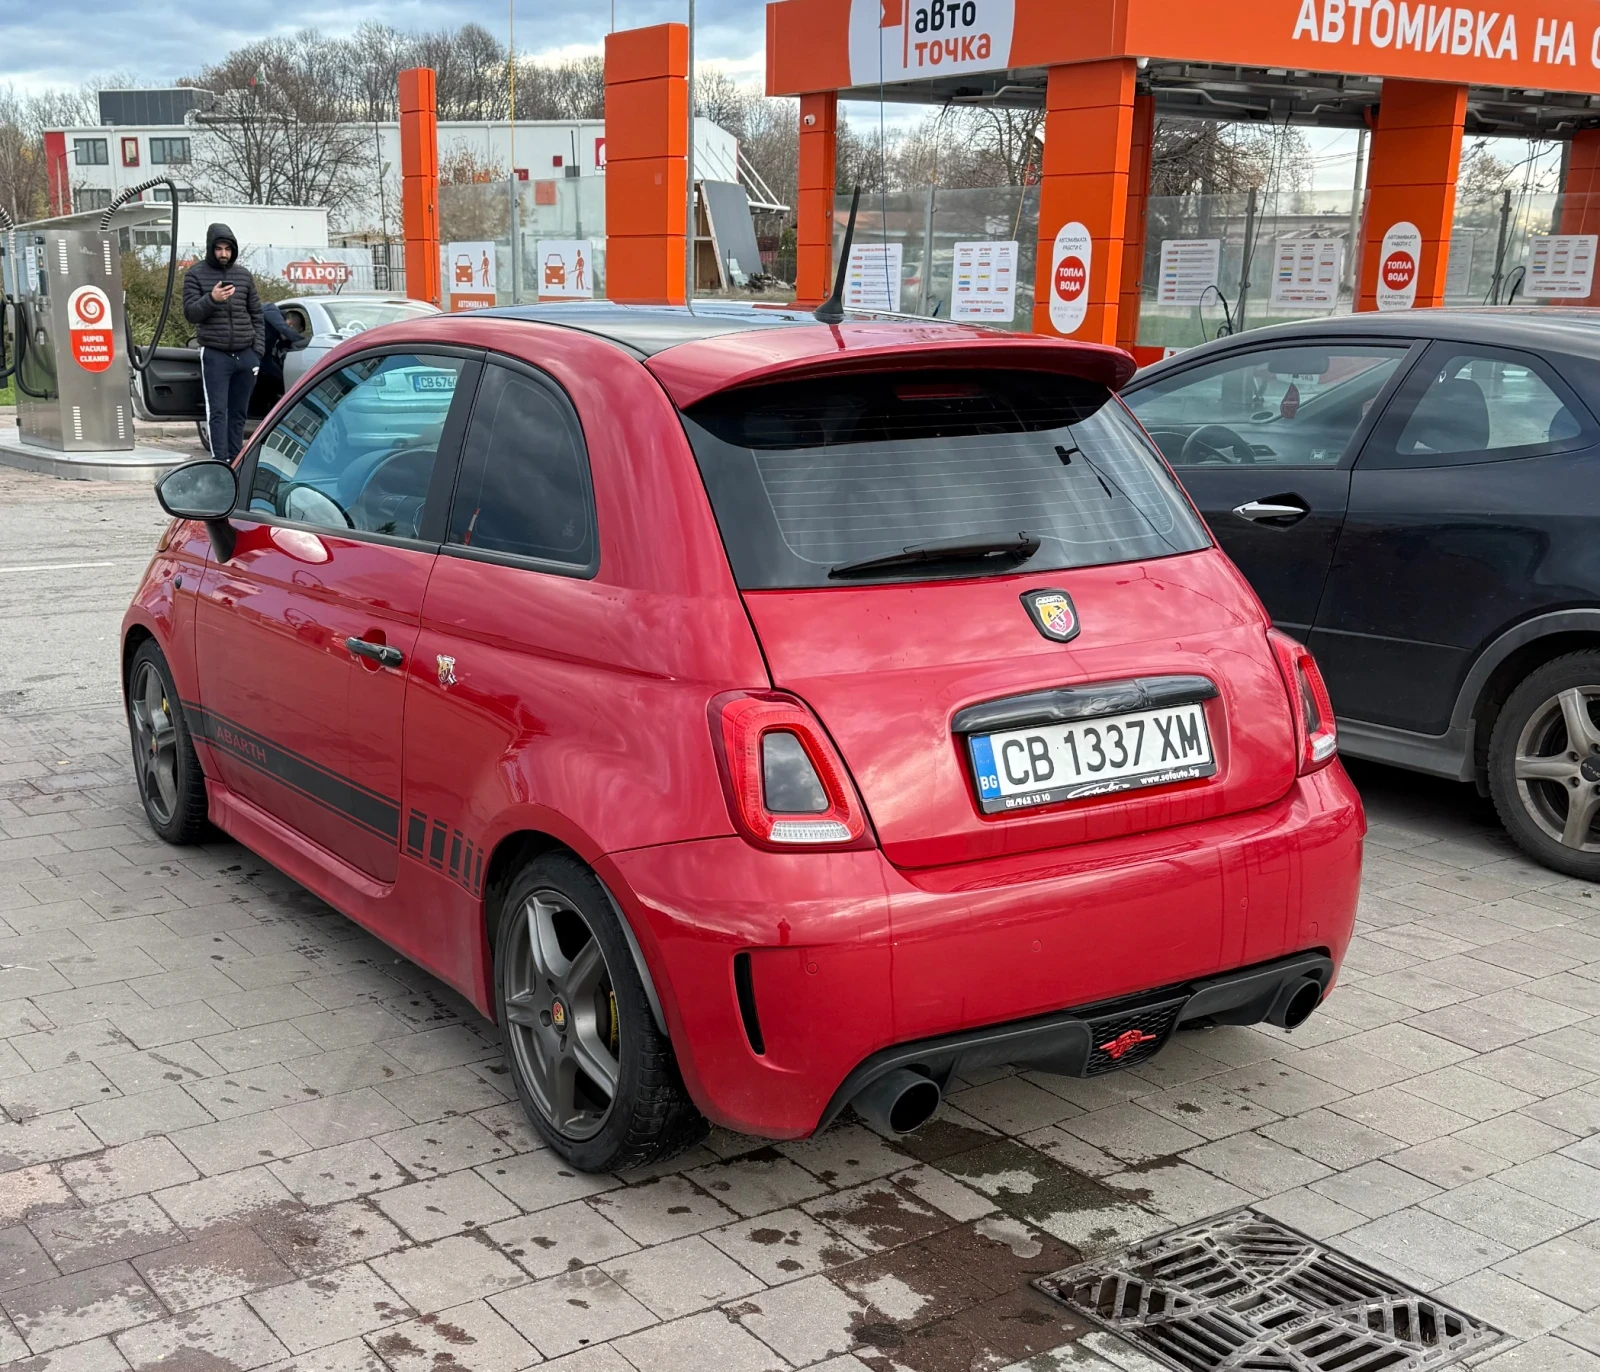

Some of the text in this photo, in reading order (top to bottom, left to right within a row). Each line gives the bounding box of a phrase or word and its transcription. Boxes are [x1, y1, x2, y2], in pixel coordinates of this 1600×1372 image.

[914, 0, 976, 34] авто
[1291, 0, 1518, 61] АВТОМИВКА
[1532, 17, 1577, 66] НА
[914, 33, 991, 66] точка
[1387, 261, 1412, 270] ТОПЛА
[1059, 267, 1083, 277] ТОПЛА
[1387, 272, 1409, 282] ВОДА
[1060, 280, 1080, 292] ВОДА
[82, 335, 104, 343] SUPER
[80, 345, 108, 353] VACUUM
[79, 355, 109, 363] CLEANER
[420, 377, 434, 388] CB
[216, 725, 267, 764] ABARTH
[1001, 712, 1203, 786] CB 1337 XM
[979, 774, 998, 791] BG
